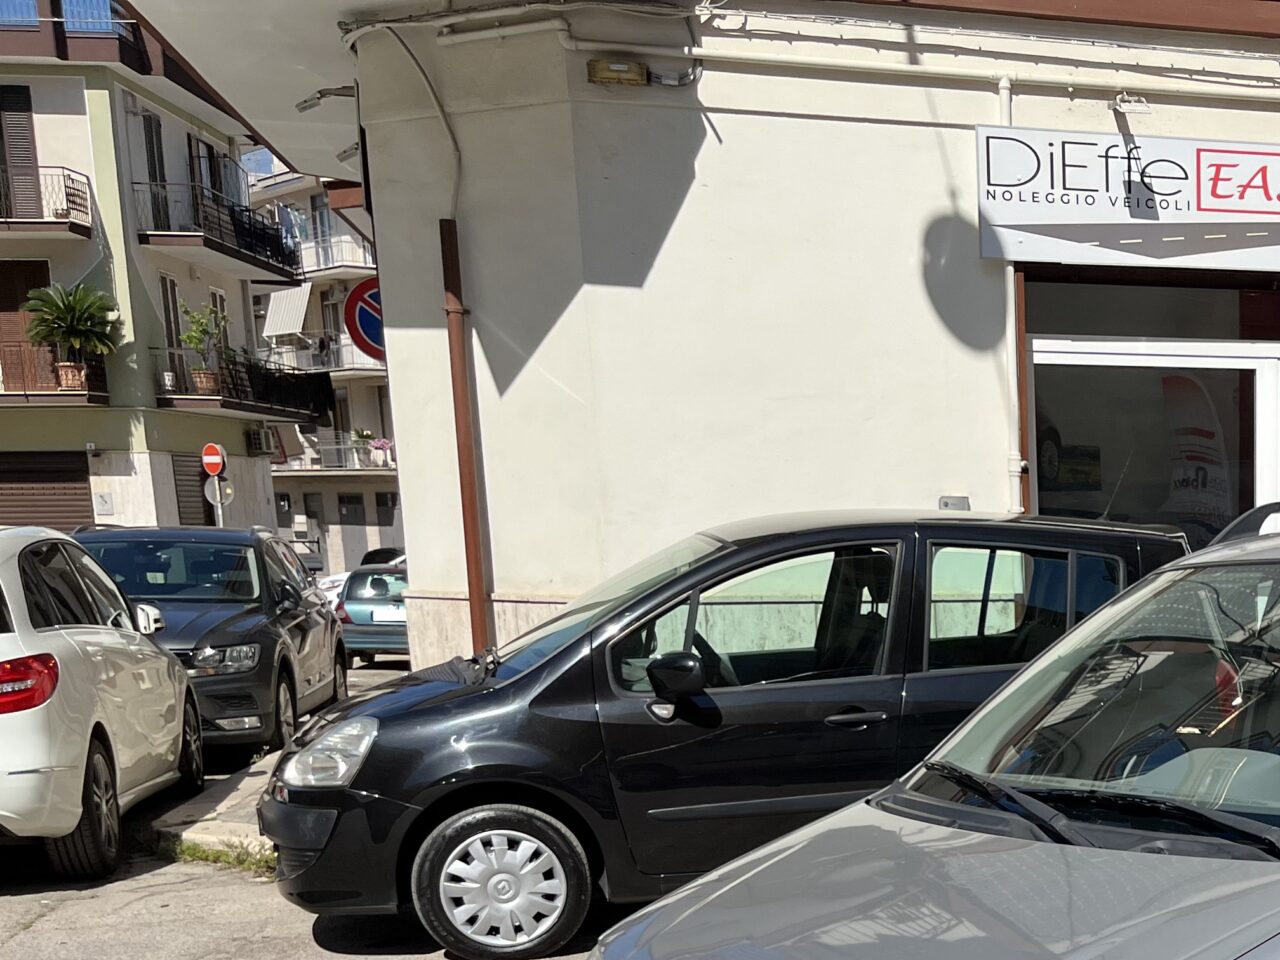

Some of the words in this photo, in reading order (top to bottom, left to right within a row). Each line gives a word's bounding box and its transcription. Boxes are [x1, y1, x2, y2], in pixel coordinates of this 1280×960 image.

[986, 136, 1189, 197] DiEffe
[986, 189, 1096, 206] NOLEGGIO
[1109, 196, 1191, 211] VEICOLI
